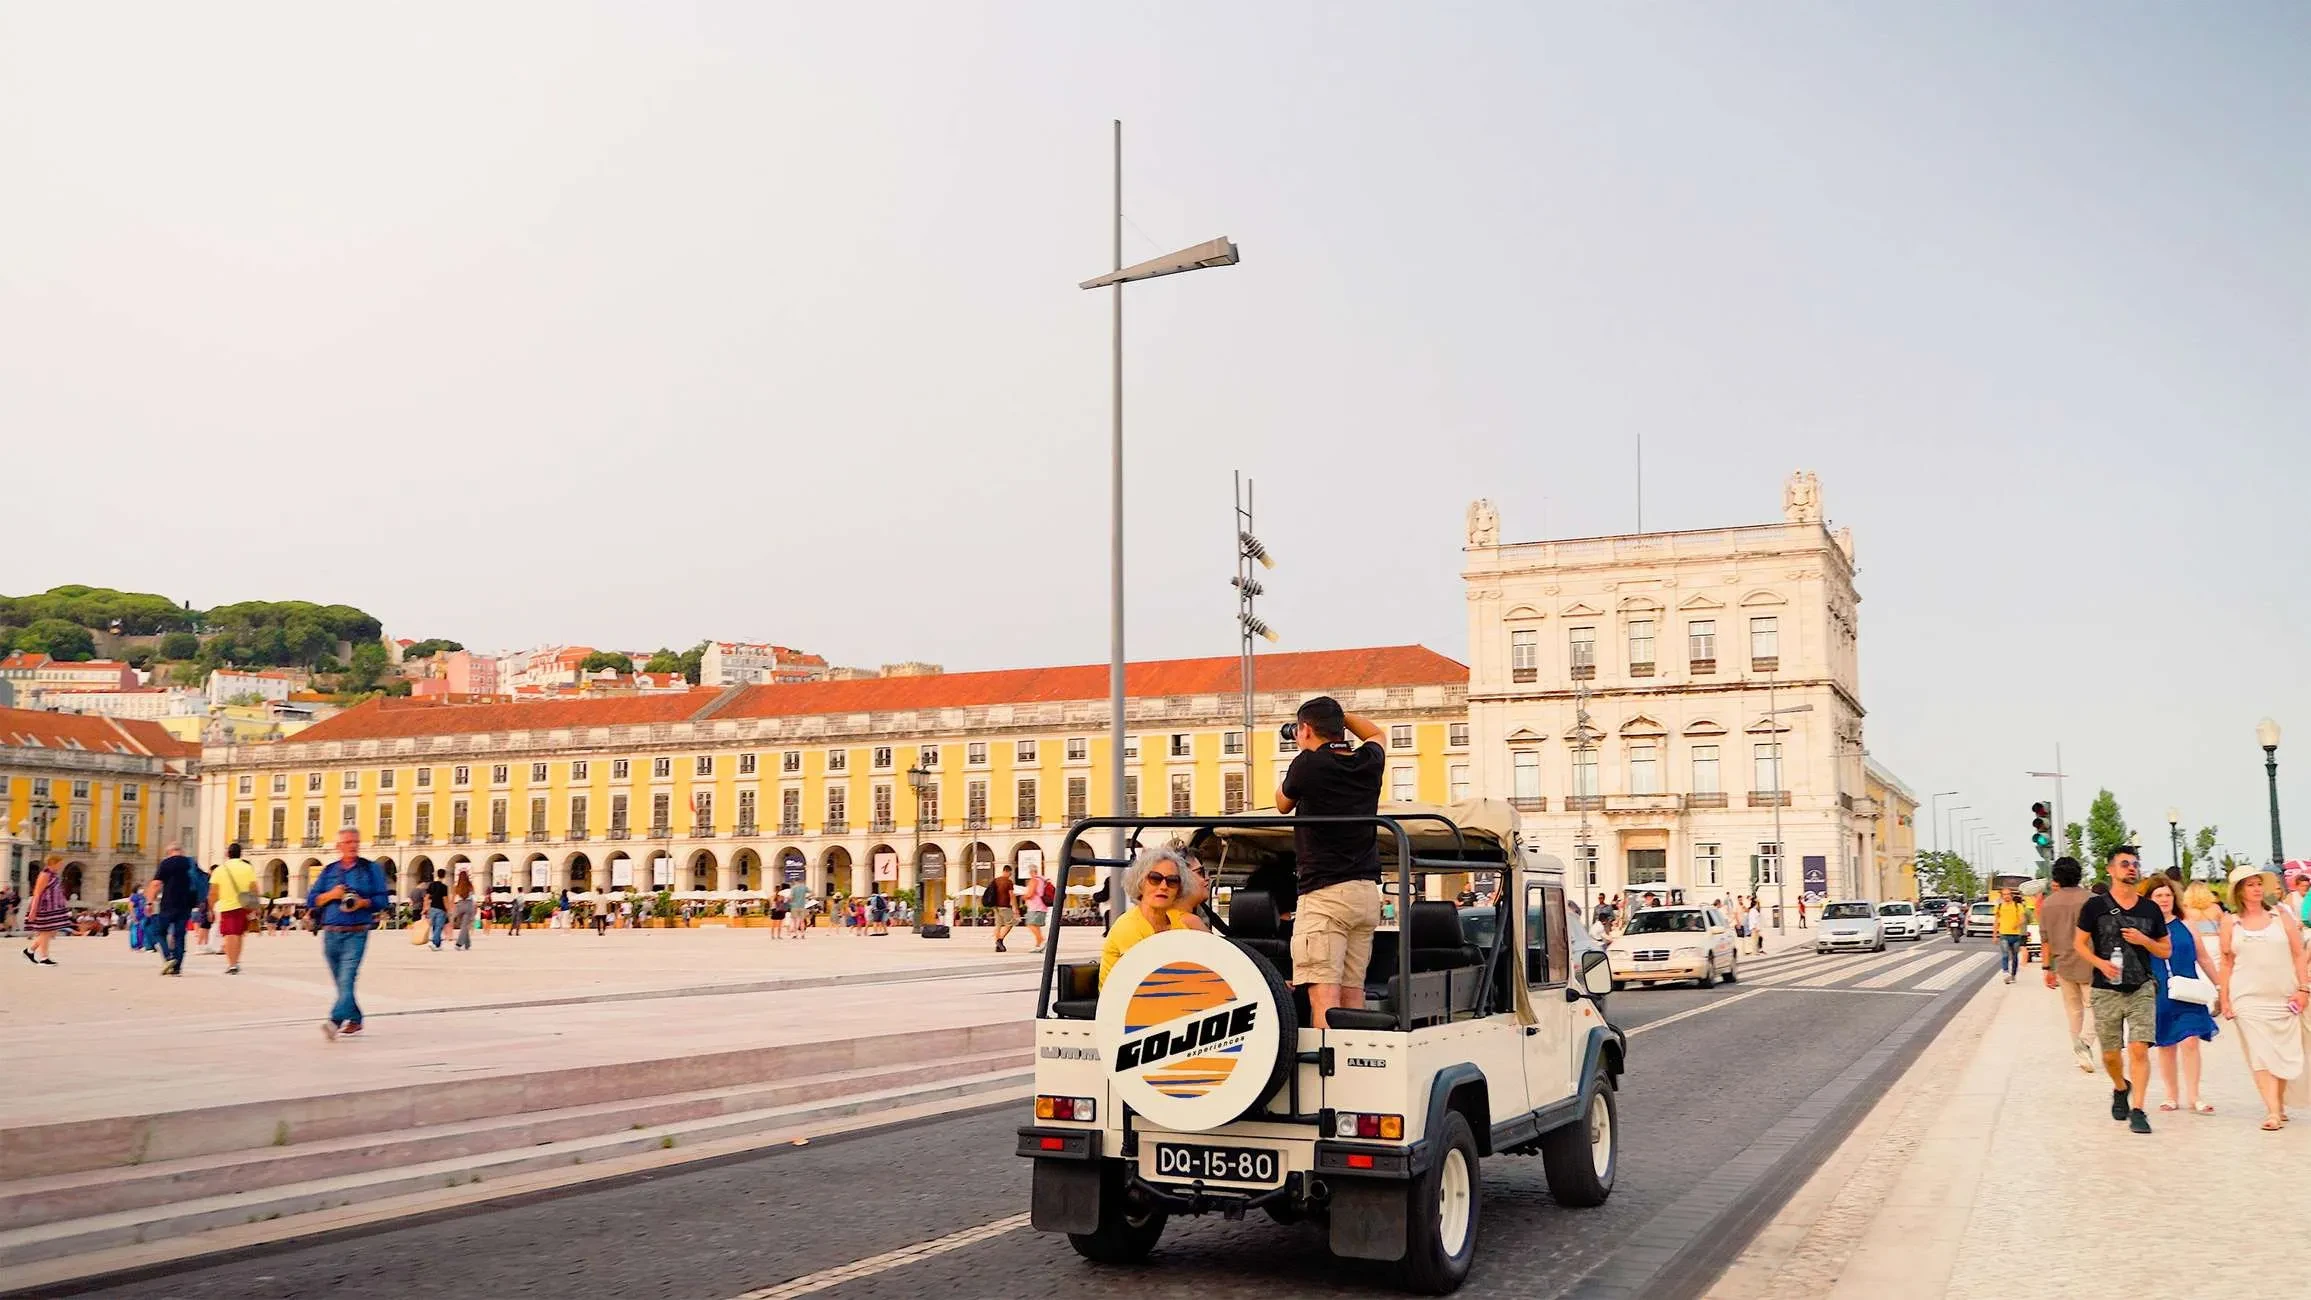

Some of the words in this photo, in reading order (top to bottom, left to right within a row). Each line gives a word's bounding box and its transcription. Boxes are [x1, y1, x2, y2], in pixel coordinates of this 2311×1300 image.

[1115, 1002, 1258, 1072] GOJOE
[1186, 1035, 1245, 1057] experiences
[1348, 1058, 1386, 1067] ALTER
[1161, 1147, 1272, 1179] DQ-15-80
